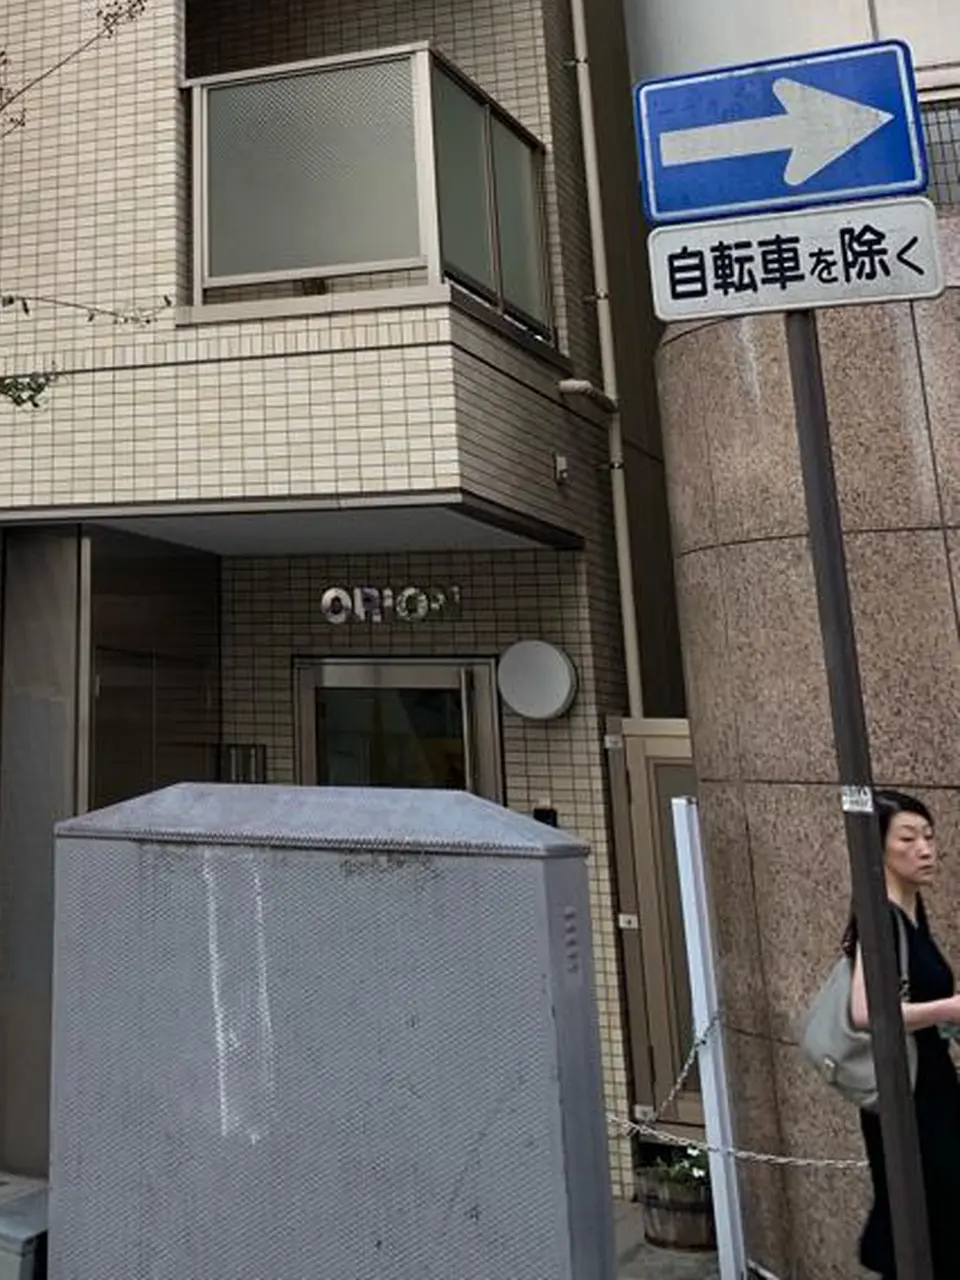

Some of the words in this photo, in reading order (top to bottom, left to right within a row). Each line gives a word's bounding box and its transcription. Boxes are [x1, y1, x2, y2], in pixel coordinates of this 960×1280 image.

[667, 223, 926, 301] 自転車を除く
